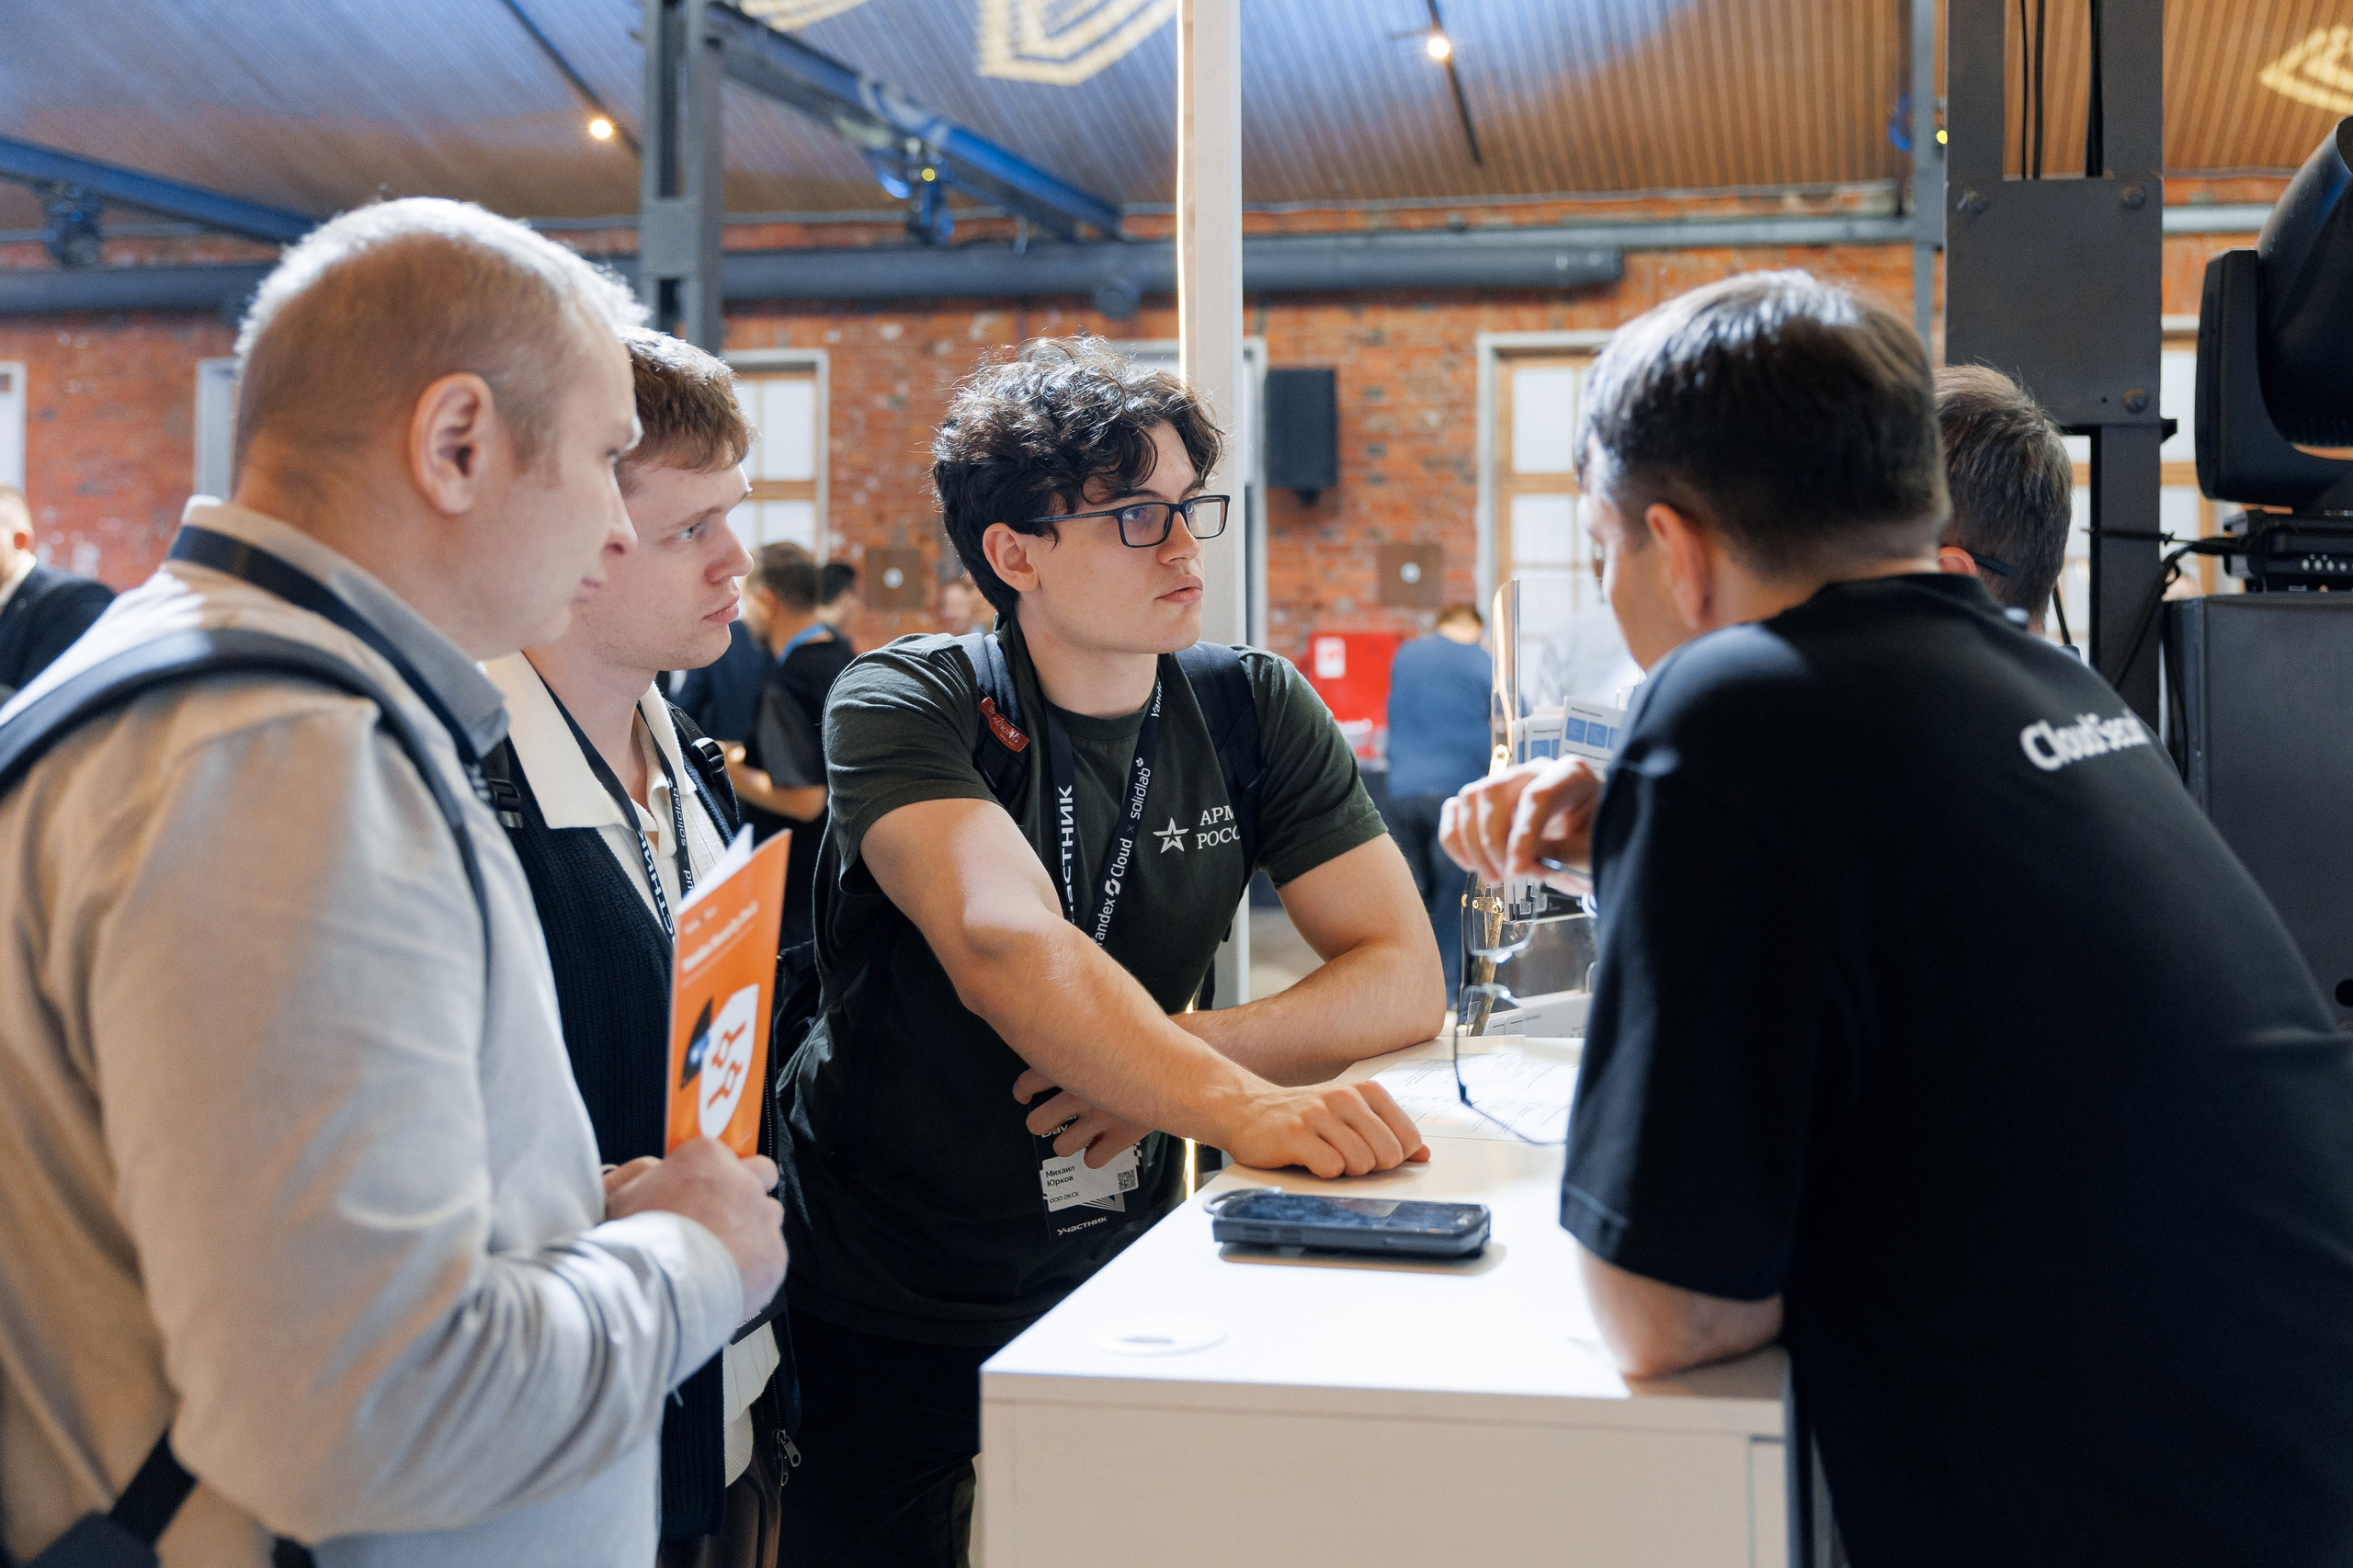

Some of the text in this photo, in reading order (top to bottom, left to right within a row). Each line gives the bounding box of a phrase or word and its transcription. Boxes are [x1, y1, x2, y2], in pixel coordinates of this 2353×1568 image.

[673, 788, 688, 846] solidlab
[1110, 837, 1133, 878] Cloud
[1130, 767, 1151, 820] solidlab
[1058, 784, 1074, 924] астник
[1045, 1165, 1075, 1178] Михаил
[1047, 1176, 1074, 1187] Юрков
[1056, 1216, 1108, 1236] Участник
